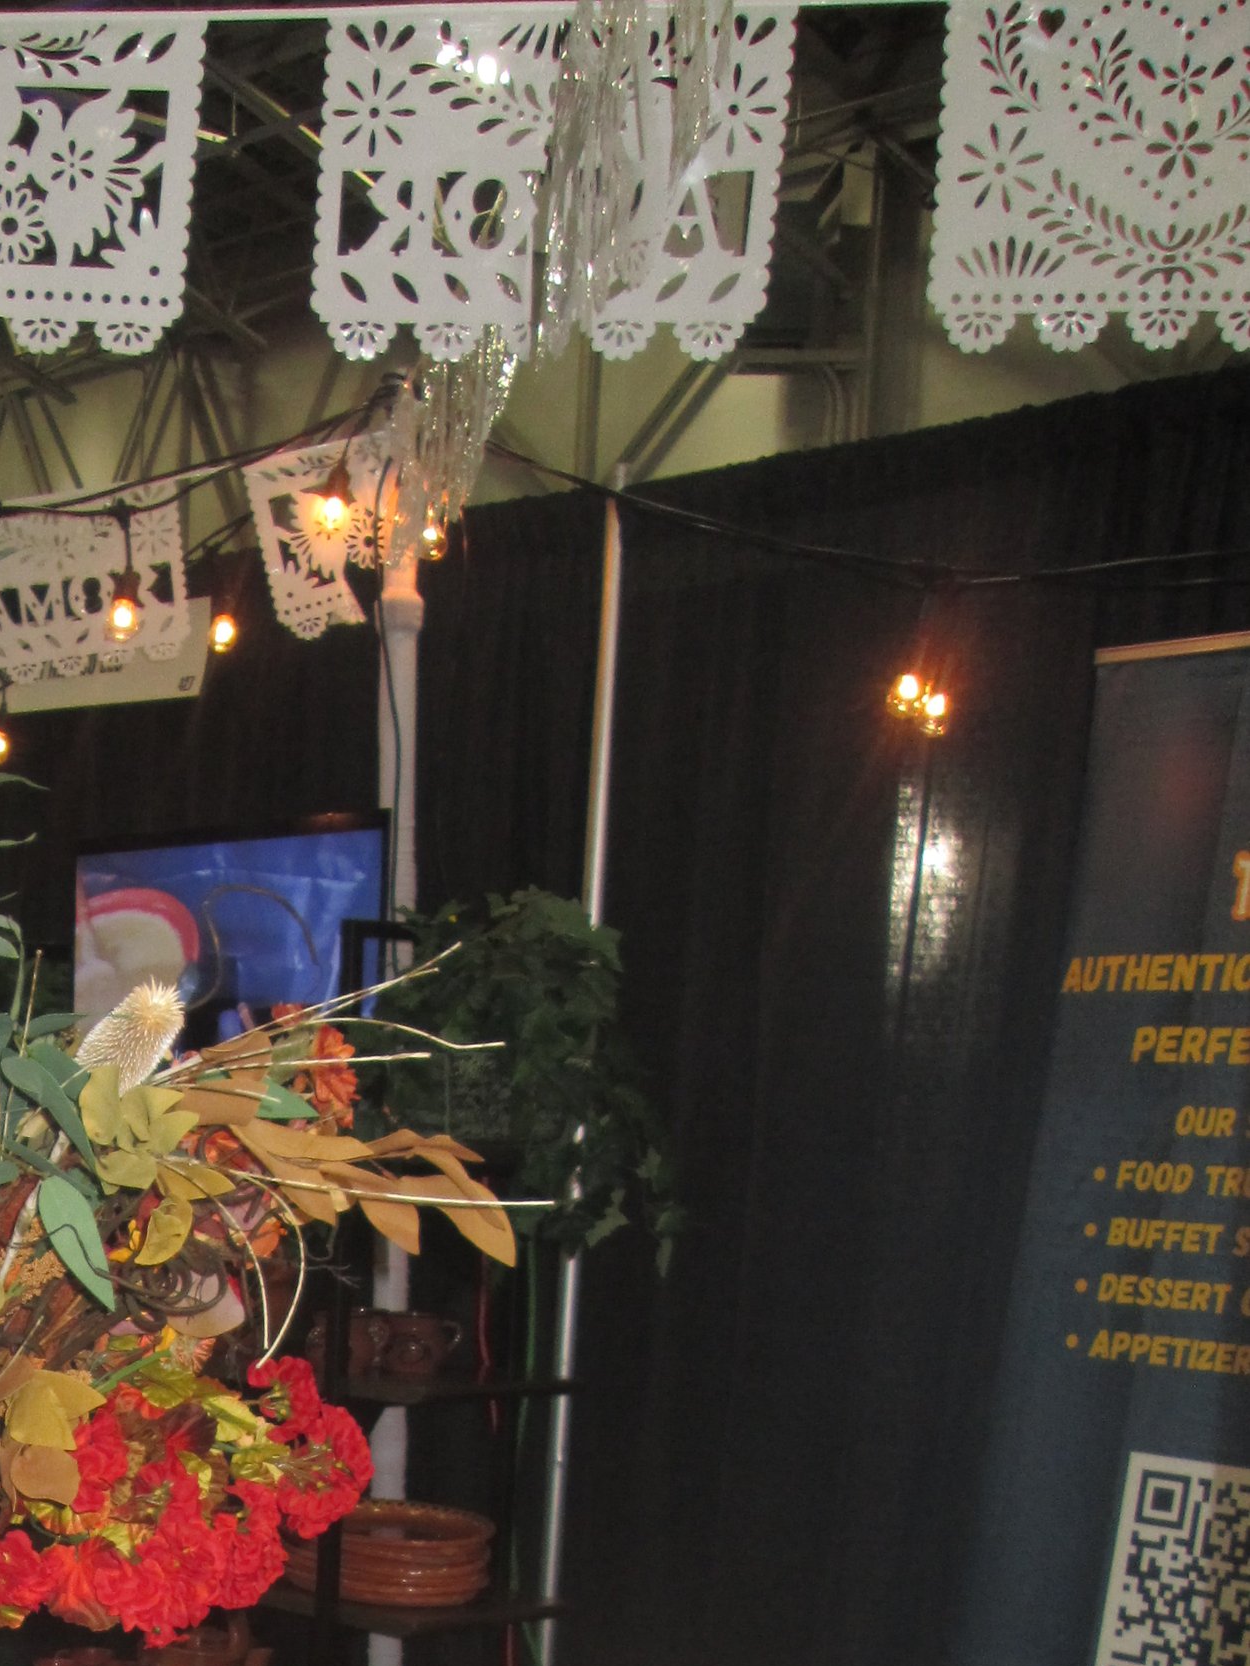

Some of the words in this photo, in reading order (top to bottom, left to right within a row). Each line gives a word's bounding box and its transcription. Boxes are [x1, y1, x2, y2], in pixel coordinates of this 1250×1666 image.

[1062, 952, 1250, 993] AUTHENTIC
[1131, 1024, 1250, 1065] PERFE
[1175, 1105, 1237, 1137] OUR
[1115, 1160, 1194, 1193] FOOD
[1106, 1217, 1225, 1254] BUFFET
[1098, 1273, 1232, 1314] DESSERT
[1088, 1329, 1250, 1375] APPETIZER
